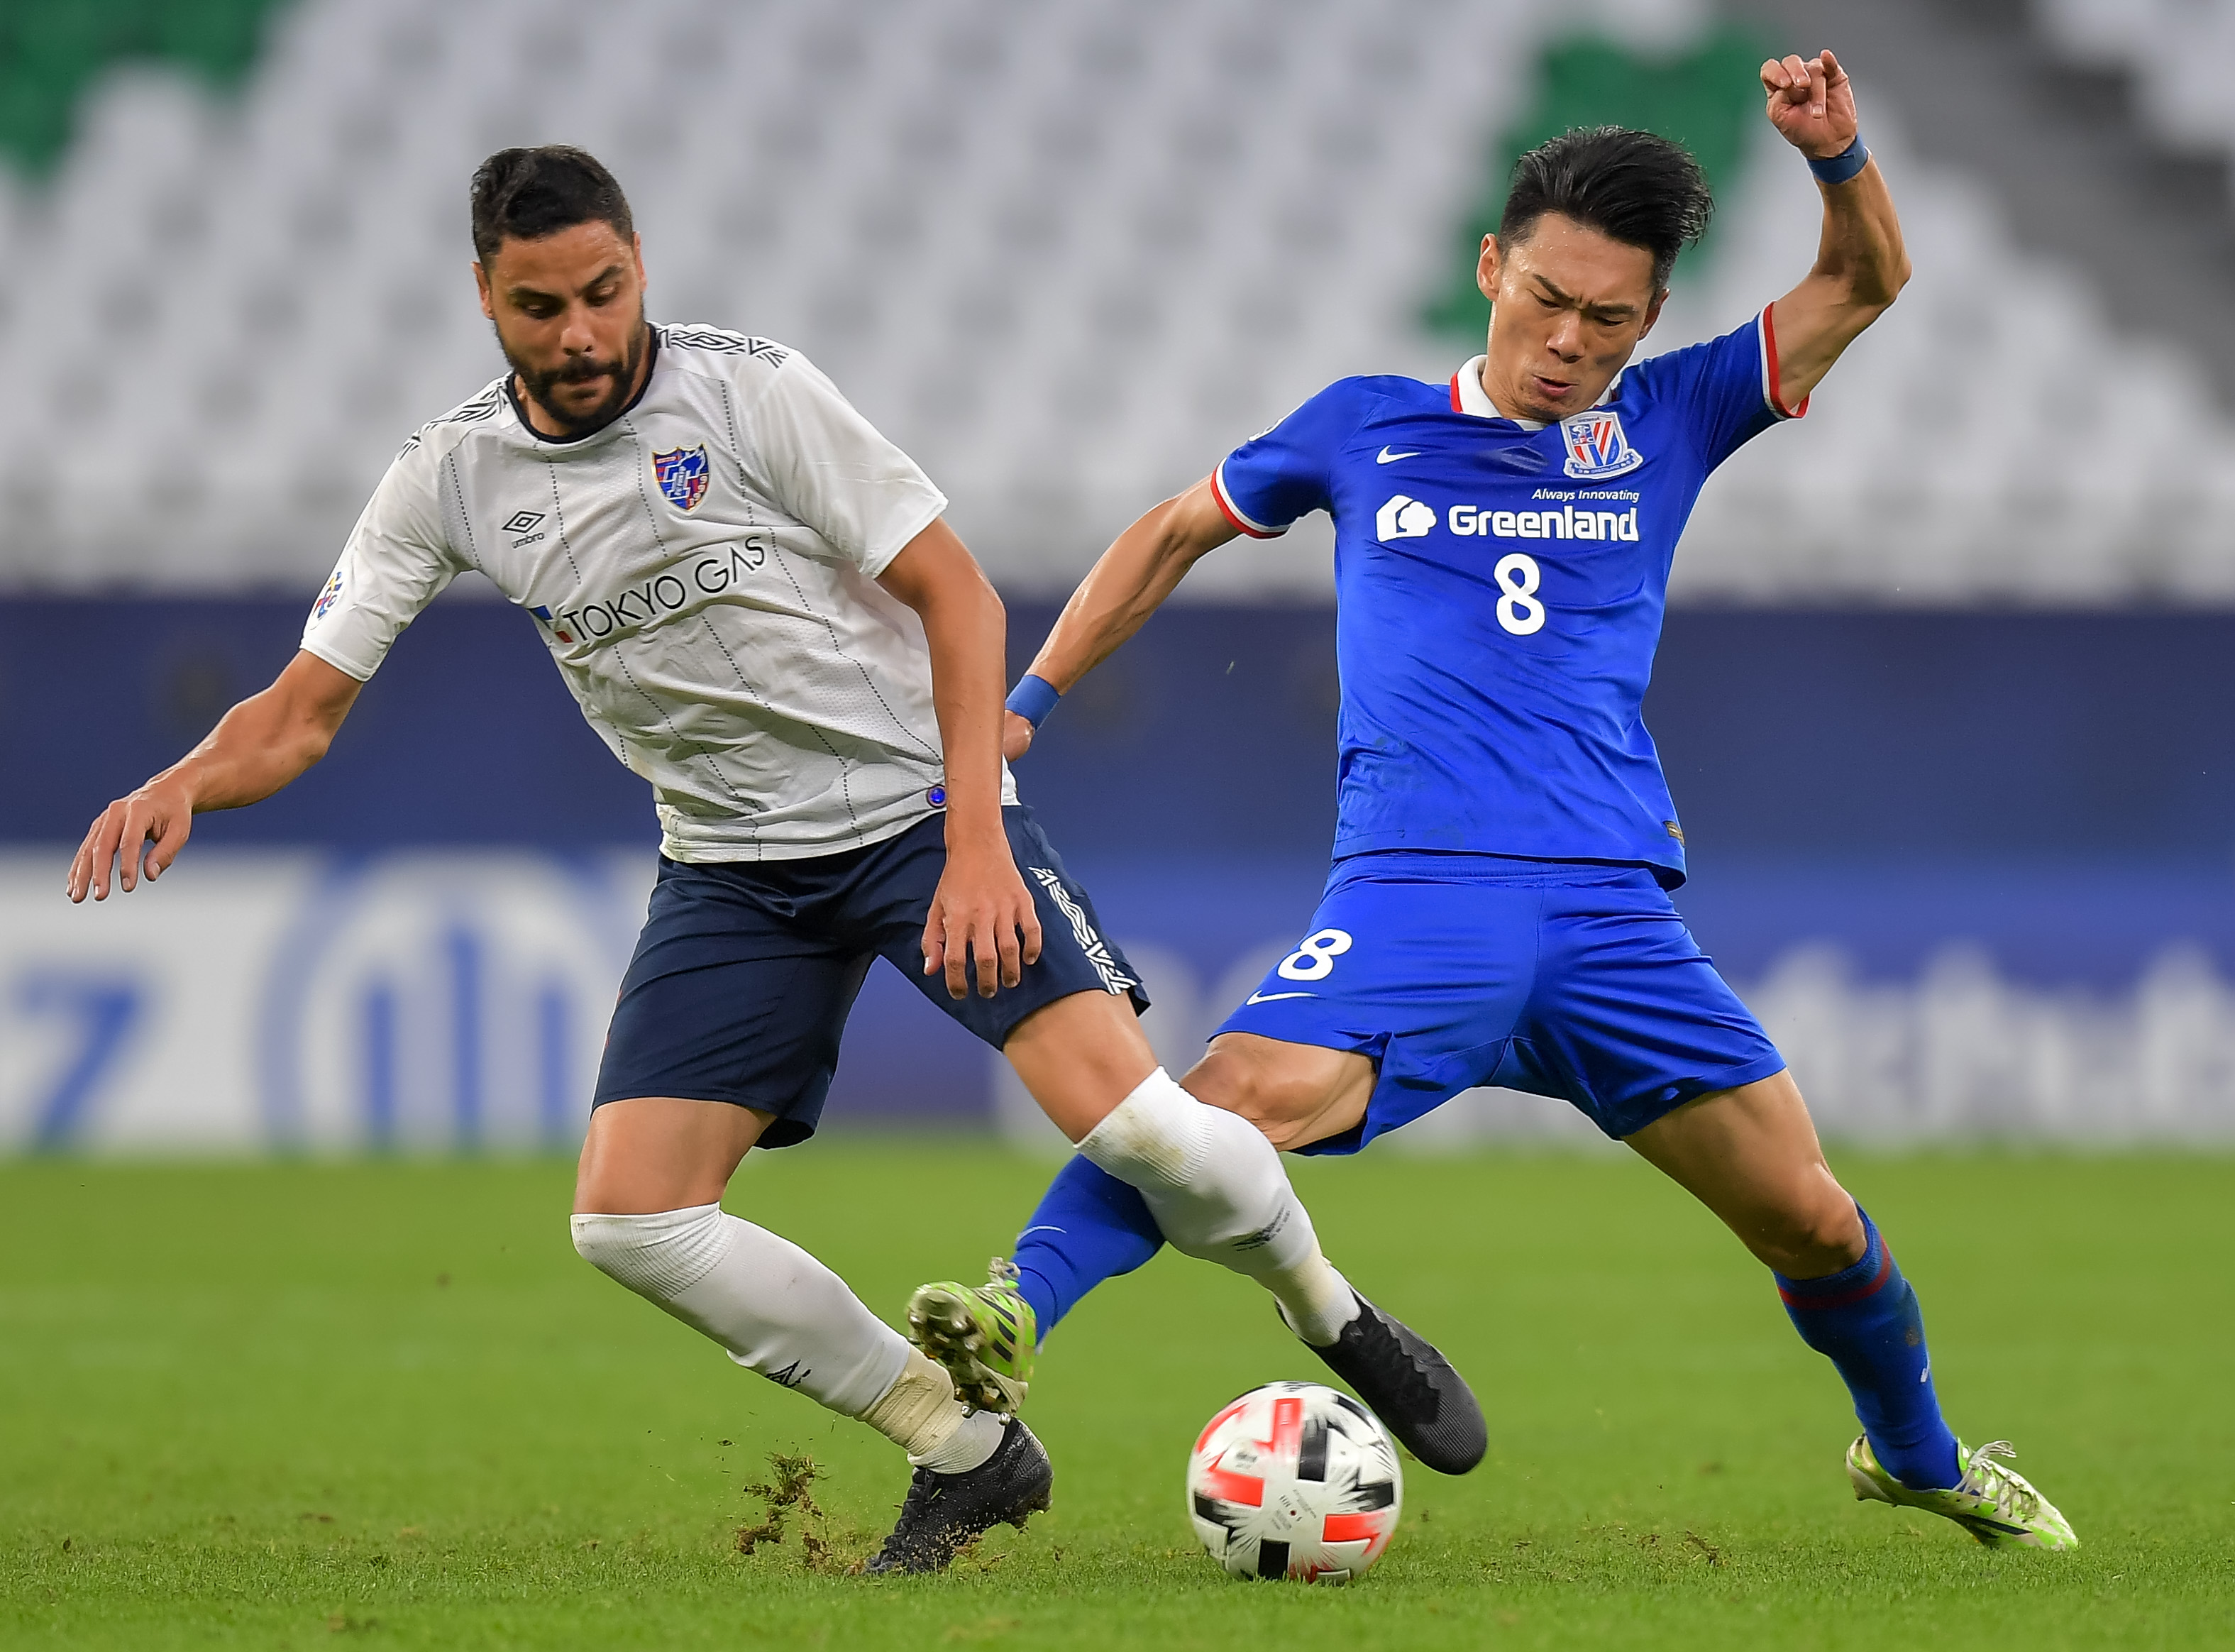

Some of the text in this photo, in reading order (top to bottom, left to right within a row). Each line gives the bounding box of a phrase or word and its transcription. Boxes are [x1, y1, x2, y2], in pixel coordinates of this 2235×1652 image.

[1531, 488, 1640, 503] Always Innovating
[1448, 505, 1640, 541] Greenland
[563, 536, 766, 641] TOKYO GAS
[1494, 553, 1545, 636] 8
[1277, 927, 1353, 981] 8
